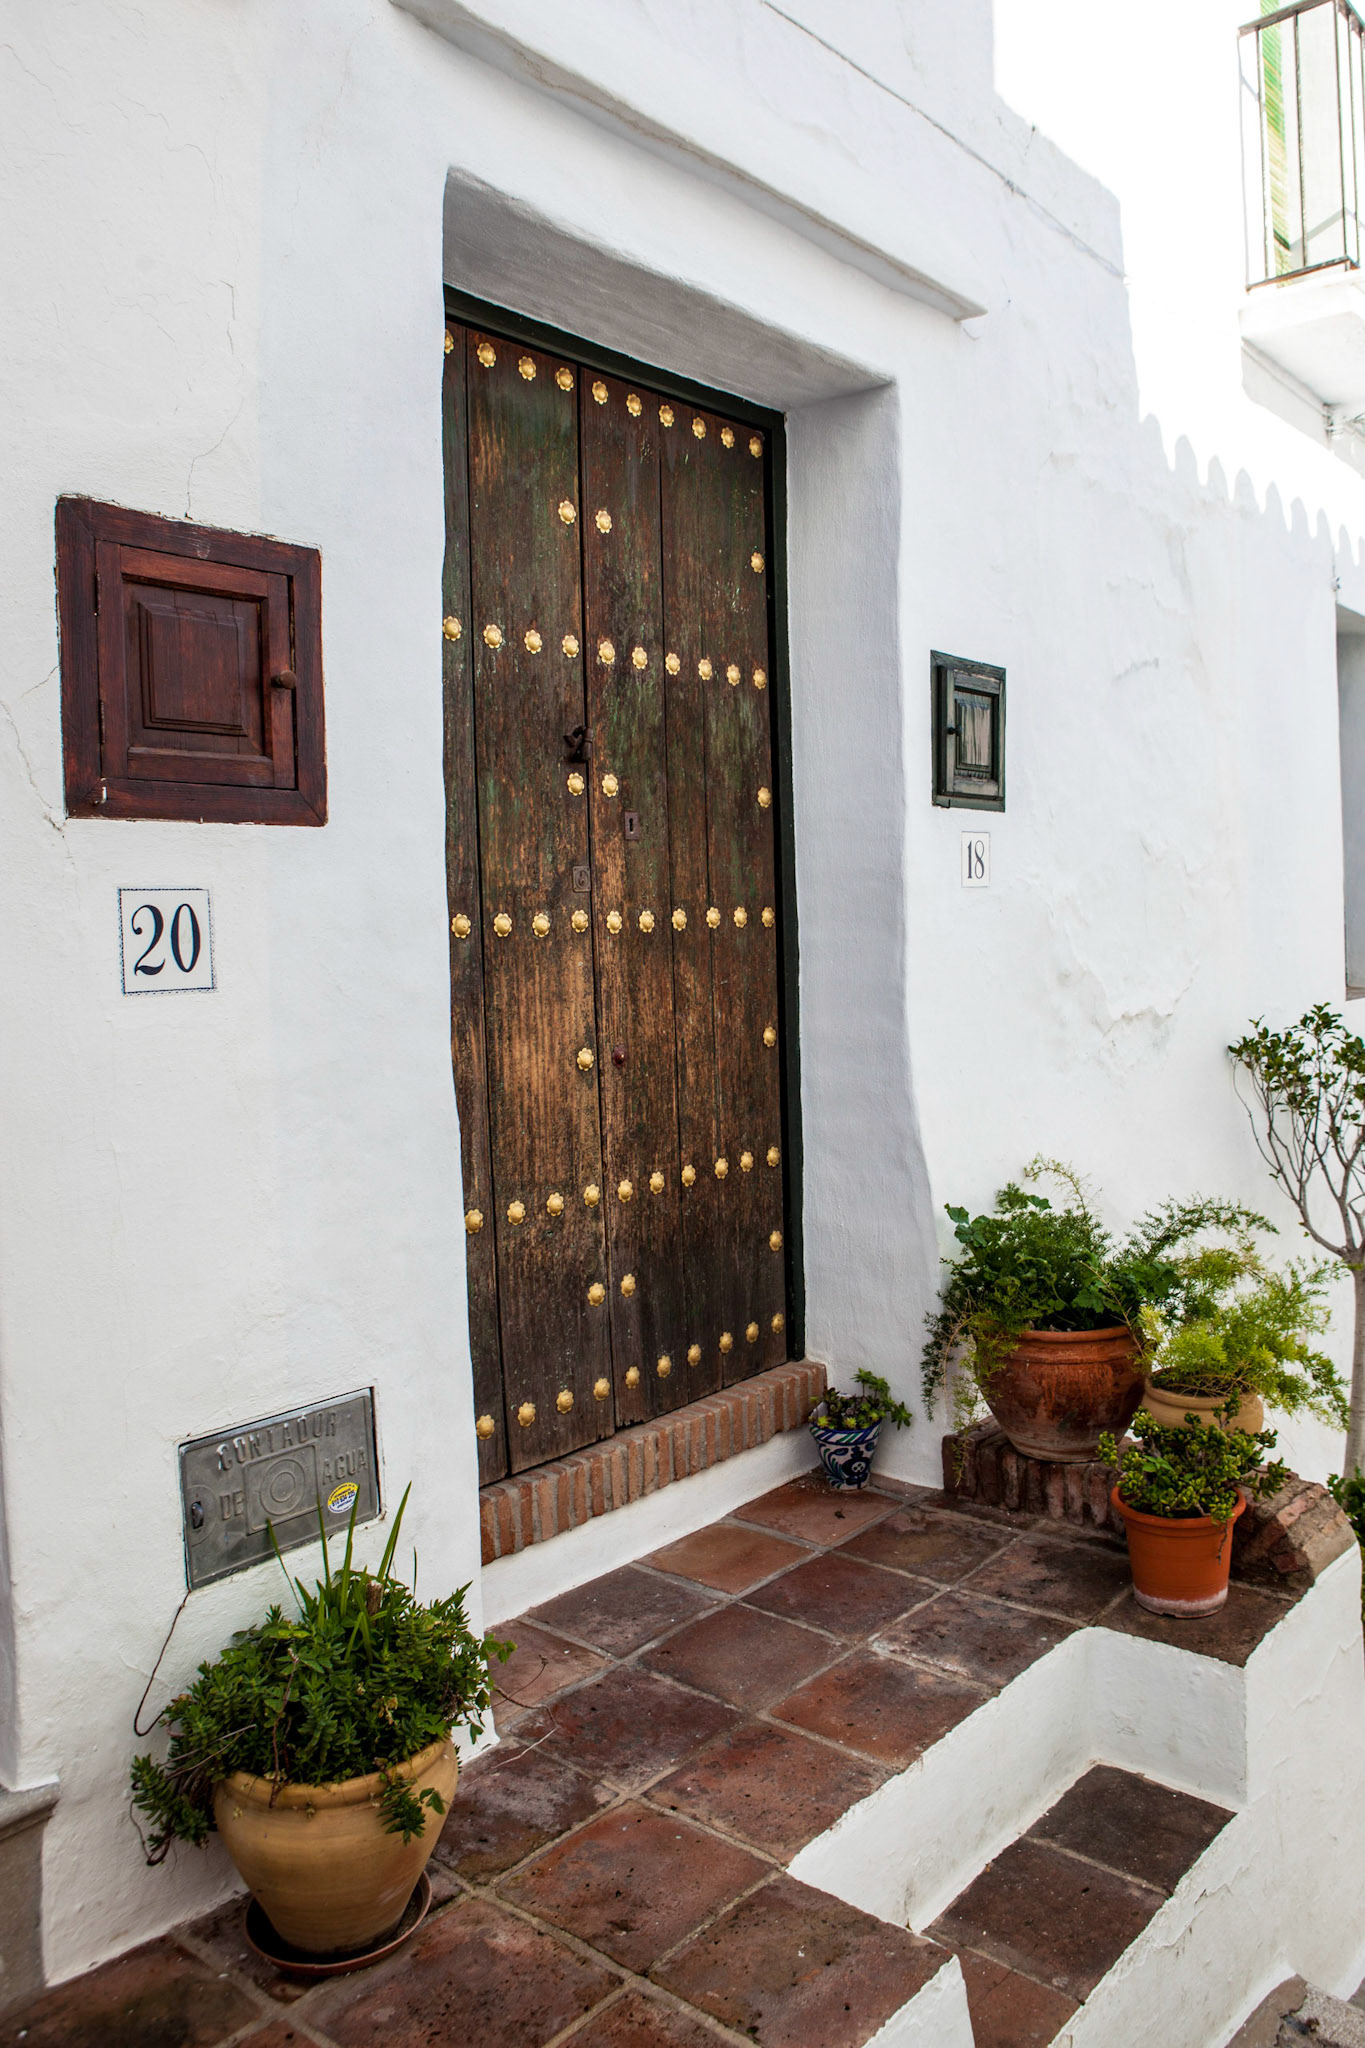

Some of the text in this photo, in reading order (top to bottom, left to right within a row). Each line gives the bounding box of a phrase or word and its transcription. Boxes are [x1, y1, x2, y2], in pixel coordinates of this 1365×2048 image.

[967, 840, 985, 879] 18
[131, 903, 201, 976] 20
[217, 1411, 338, 1471] CONTADOR
[220, 1446, 367, 1521] DE AGUA
